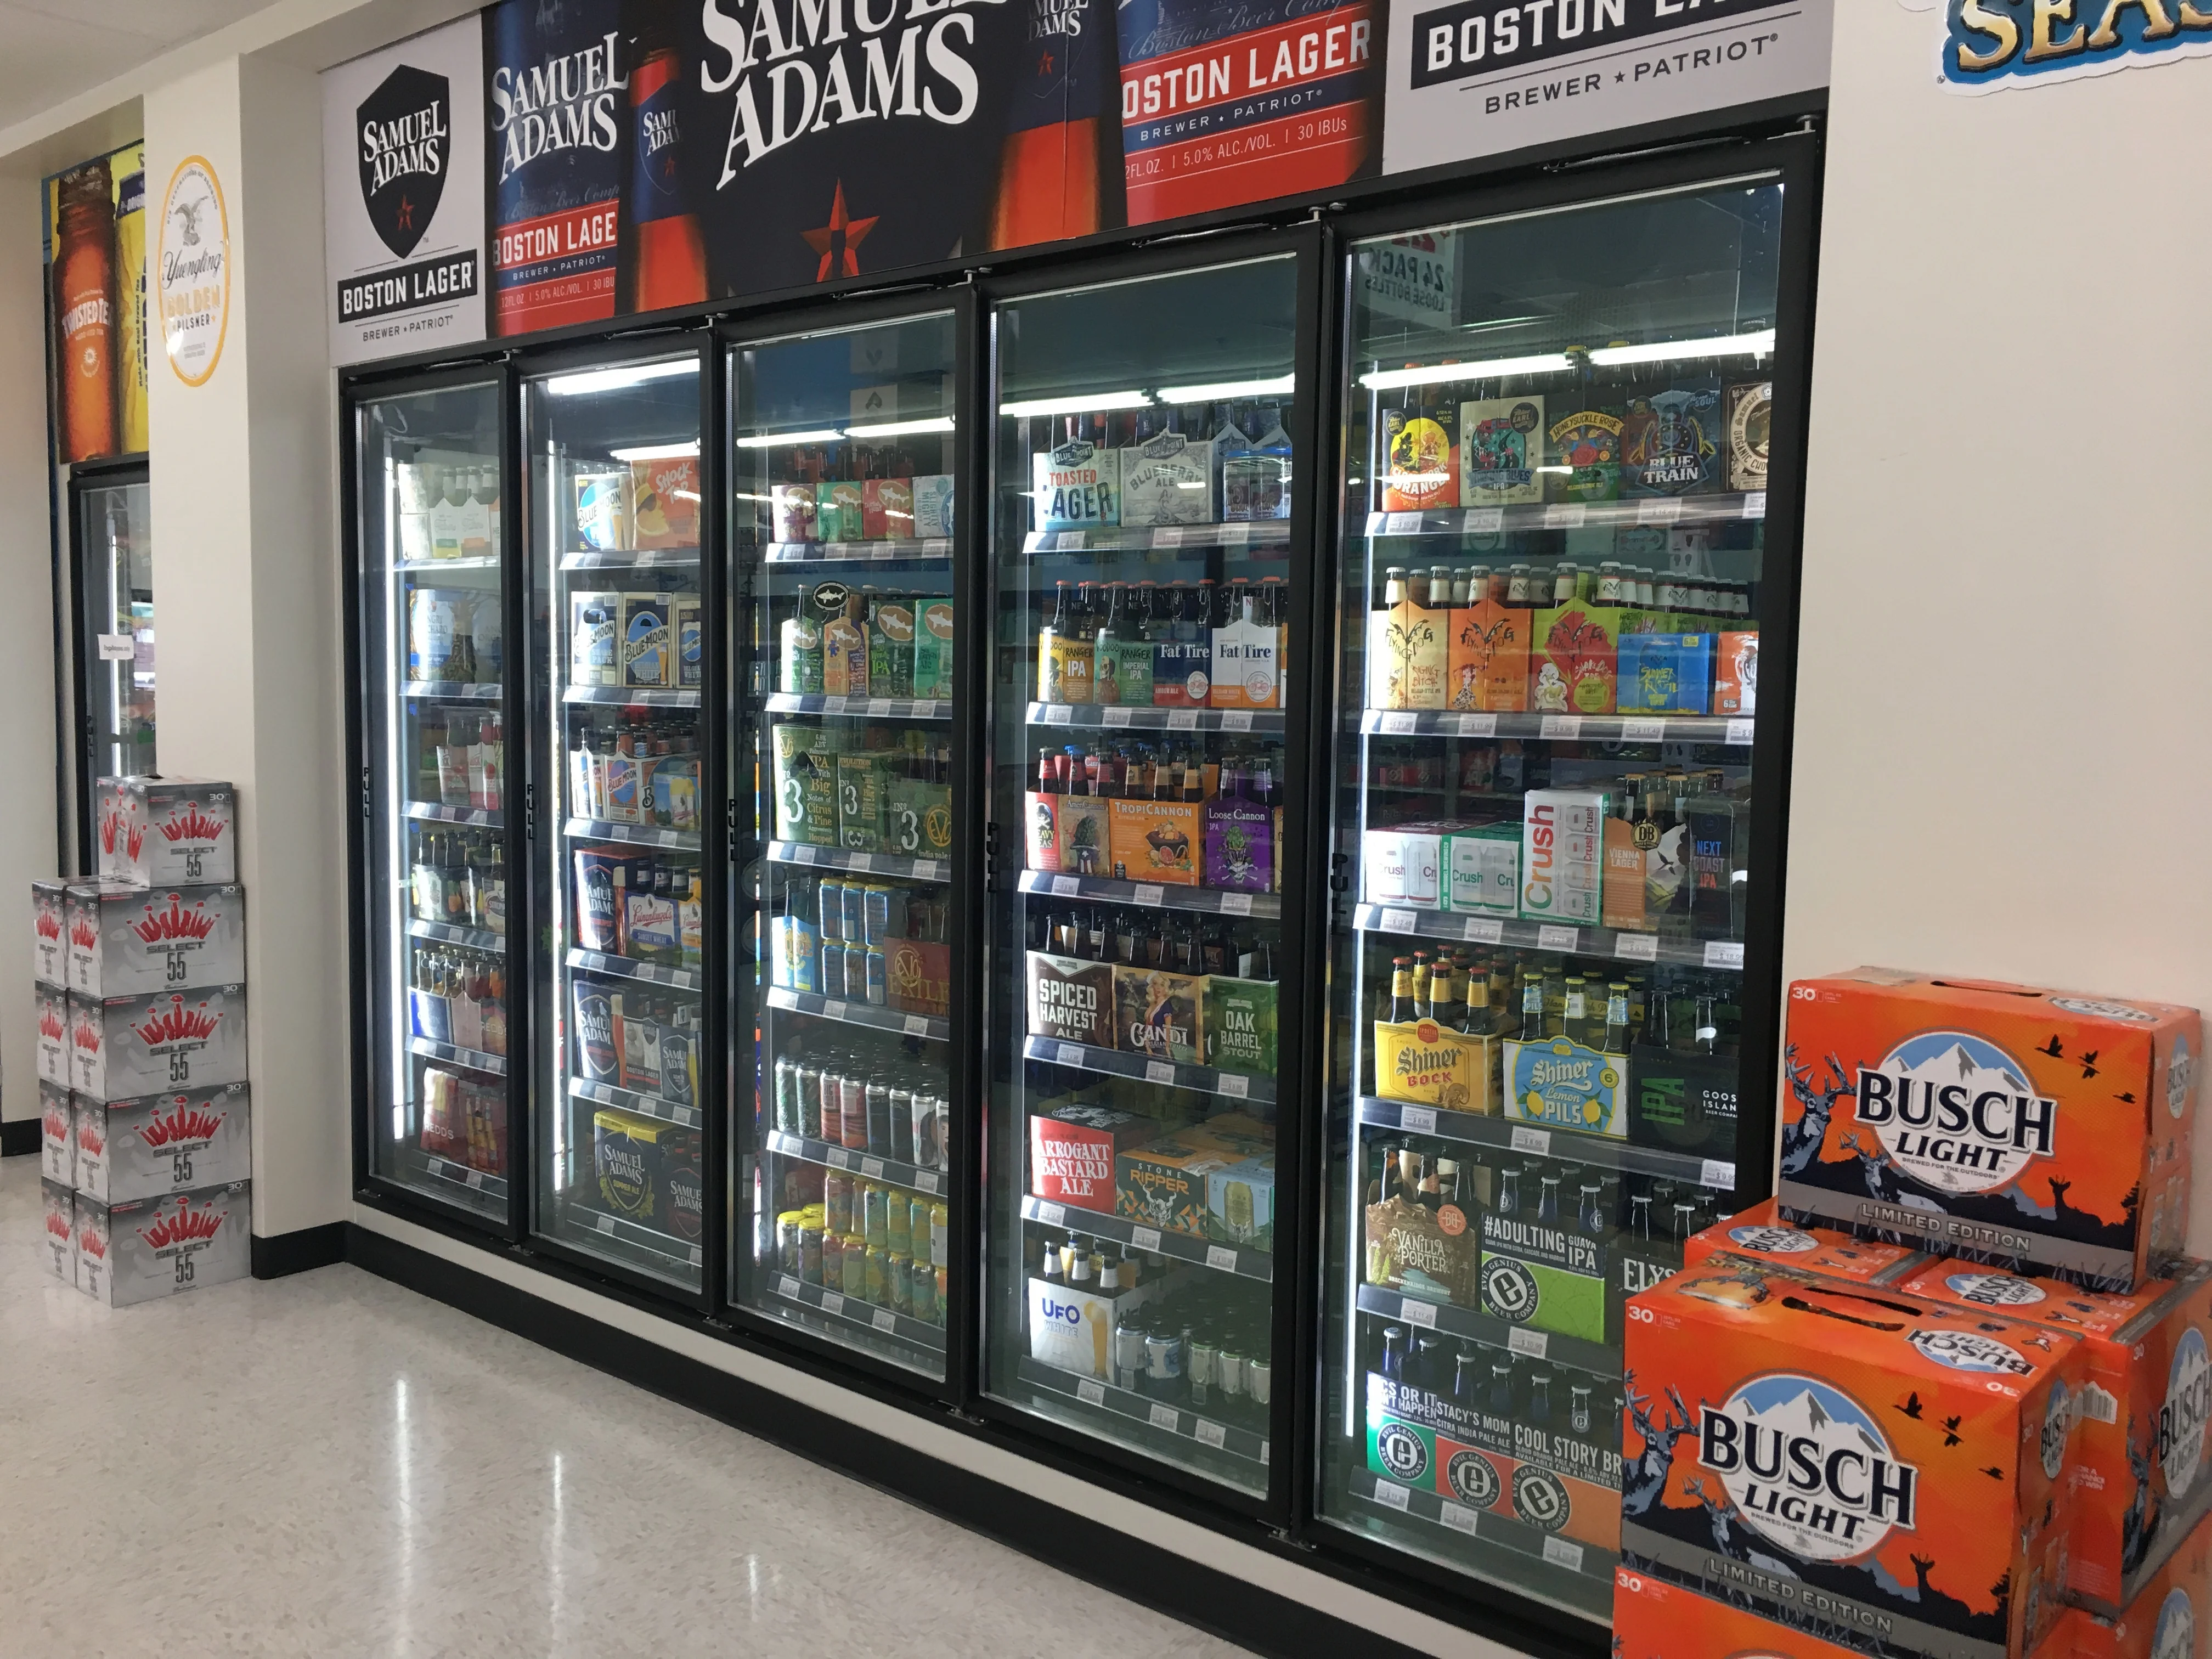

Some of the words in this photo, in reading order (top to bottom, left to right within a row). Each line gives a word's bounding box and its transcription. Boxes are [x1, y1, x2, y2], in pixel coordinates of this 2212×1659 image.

[1427, 0, 1626, 71] BOSTON
[1249, 19, 1370, 89] LAGER
[492, 31, 629, 131] SAMUEL
[1485, 74, 1601, 114] BREWER
[1634, 35, 1769, 81] PATRIOT
[716, 13, 978, 190] ADAMS
[1141, 116, 1210, 142] BREWER
[1234, 91, 1314, 119] PATRIOT
[364, 101, 447, 161] SAMUEL
[499, 93, 617, 185] ADAMS
[370, 139, 440, 196] ADAMS
[162, 241, 224, 289] Yuengling
[513, 267, 549, 280] BREWER
[560, 256, 601, 271] PATRIOT
[167, 285, 220, 318] GOLDEN
[342, 278, 408, 315] BOSTON
[414, 265, 473, 300] LAGER
[177, 313, 210, 330] PILSNER
[363, 326, 400, 341] BREWER
[409, 317, 450, 332] PATRIOT
[1554, 415, 1599, 437] HONEYSUCKLE
[1599, 416, 1620, 431] ROSE
[1649, 455, 1694, 471] BLUE
[656, 462, 693, 493] SHOCK
[1049, 469, 1097, 487] TOASTED
[1155, 477, 1175, 488] ALE
[1644, 467, 1699, 484] TRAIN
[624, 640, 646, 664] BLUE
[645, 626, 669, 644] MOON
[1065, 646, 1093, 658] RANGER
[1121, 647, 1151, 660] RANGER
[1160, 644, 1181, 658] Fat
[1184, 644, 1210, 658] Tire
[1220, 644, 1240, 659] Fat
[1242, 644, 1272, 659] Tire
[872, 660, 890, 675] IPA
[1067, 660, 1086, 678] IPA
[1122, 661, 1150, 670] IMPERIAL
[1130, 669, 1143, 680] IPA
[784, 778, 804, 822] 3
[845, 785, 857, 815] 3
[1067, 799, 1105, 810] AmeriCannon
[1209, 808, 1232, 820] Loose
[1234, 808, 1265, 821] Cannon
[1584, 806, 1593, 833] Crush
[901, 810, 919, 850] 3
[170, 847, 217, 855] SELECT
[1525, 805, 1554, 909] Crush
[1583, 834, 1593, 862] Crush
[1609, 848, 1640, 860] VIENNA
[1696, 840, 1722, 856] NEXT
[186, 854, 201, 877] 55
[1611, 858, 1638, 870] LAGER
[1694, 857, 1725, 873] COAST
[1699, 873, 1717, 889] IPA
[1582, 891, 1592, 918] Crush
[145, 941, 206, 954] SELECT
[167, 951, 187, 981] 55
[223, 984, 238, 992] 30
[1040, 979, 1097, 1011] SPICED
[1792, 987, 1815, 1001] 30
[1040, 1003, 1097, 1030] HARVEST
[1225, 1011, 1255, 1032] OAK
[1056, 1026, 1082, 1041] ALE
[1221, 1030, 1262, 1050] BARREL
[149, 1041, 208, 1056] SELECT
[1223, 1046, 1261, 1059] STOUT
[169, 1052, 189, 1082] 55
[1396, 1047, 1463, 1075] Shiner
[1531, 1059, 1593, 1087] Shiner
[227, 1083, 242, 1092] 30
[1407, 1071, 1453, 1088] BOCK
[1545, 1089, 1581, 1103] Lemon
[1641, 1078, 1684, 1126] IPA
[1545, 1102, 1582, 1124] PILS
[1858, 1069, 2056, 1153] BUSCH
[153, 1141, 212, 1156] SELECT
[605, 1145, 645, 1172] SAMUEL
[1894, 1132, 2007, 1172] LIGHT
[173, 1152, 193, 1182] 55
[609, 1161, 642, 1185] ADAMS
[1043, 1157, 1108, 1180] BASTARD
[1138, 1163, 1182, 1179] STONE
[228, 1182, 242, 1190] 30
[1060, 1177, 1093, 1197] ALE
[1131, 1169, 1189, 1195] RIPPER
[1485, 1216, 1565, 1254] #ADULTING
[1861, 1203, 1943, 1232] LIMITED
[1948, 1221, 2031, 1251] EDITION
[155, 1240, 213, 1259] SELECT
[1392, 1227, 1446, 1257] VANILLA
[1568, 1235, 1596, 1250] GUAVA
[176, 1252, 195, 1283] 55
[1398, 1246, 1450, 1274] PORTER
[1488, 1260, 1521, 1272] GENIUS
[1568, 1246, 1596, 1270] IPA
[1042, 1297, 1080, 1324] UFO
[1488, 1301, 1512, 1319] BEER
[1515, 1280, 1536, 1320] COMPANY
[1628, 1306, 1654, 1324] 30
[1043, 1319, 1079, 1338] WHITE
[1436, 1418, 1455, 1433] CITRA
[1458, 1425, 1477, 1438] INDIA
[1479, 1432, 1496, 1444] PALE
[1497, 1438, 1511, 1448] ALE
[1483, 1415, 1510, 1435] MOM
[1397, 1425, 1423, 1451] GENIUS
[1515, 1424, 1550, 1454] COOL
[1554, 1435, 1597, 1466] STORY
[1700, 1406, 1918, 1531] BUSCH
[1743, 1483, 1865, 1542] LIGHT
[1618, 1572, 1642, 1592] 30
[1707, 1558, 1796, 1599] LIMITED
[1801, 1590, 1893, 1636] EDITION
